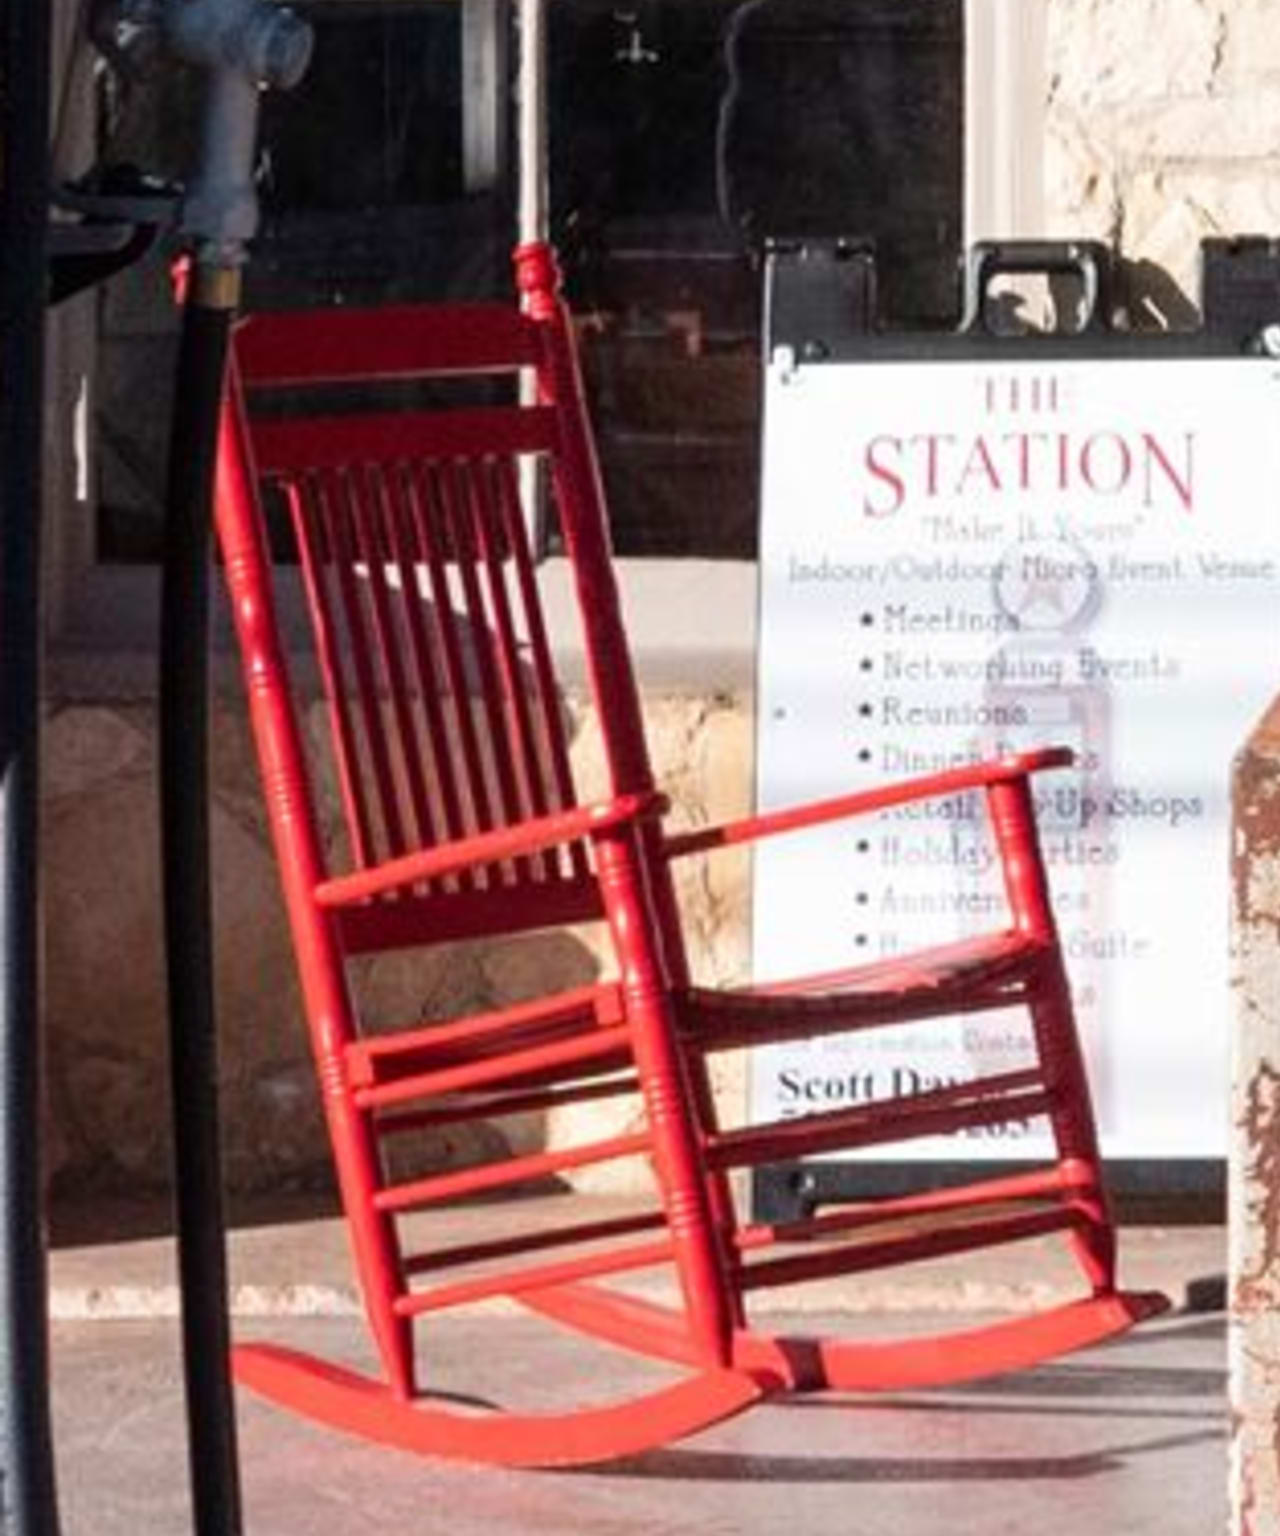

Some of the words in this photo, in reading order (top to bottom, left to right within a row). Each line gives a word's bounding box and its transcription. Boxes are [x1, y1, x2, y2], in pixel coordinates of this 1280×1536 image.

[862, 430, 1198, 520] STATION
[881, 695, 1029, 728] Reunions
[777, 1067, 876, 1102] Scott
